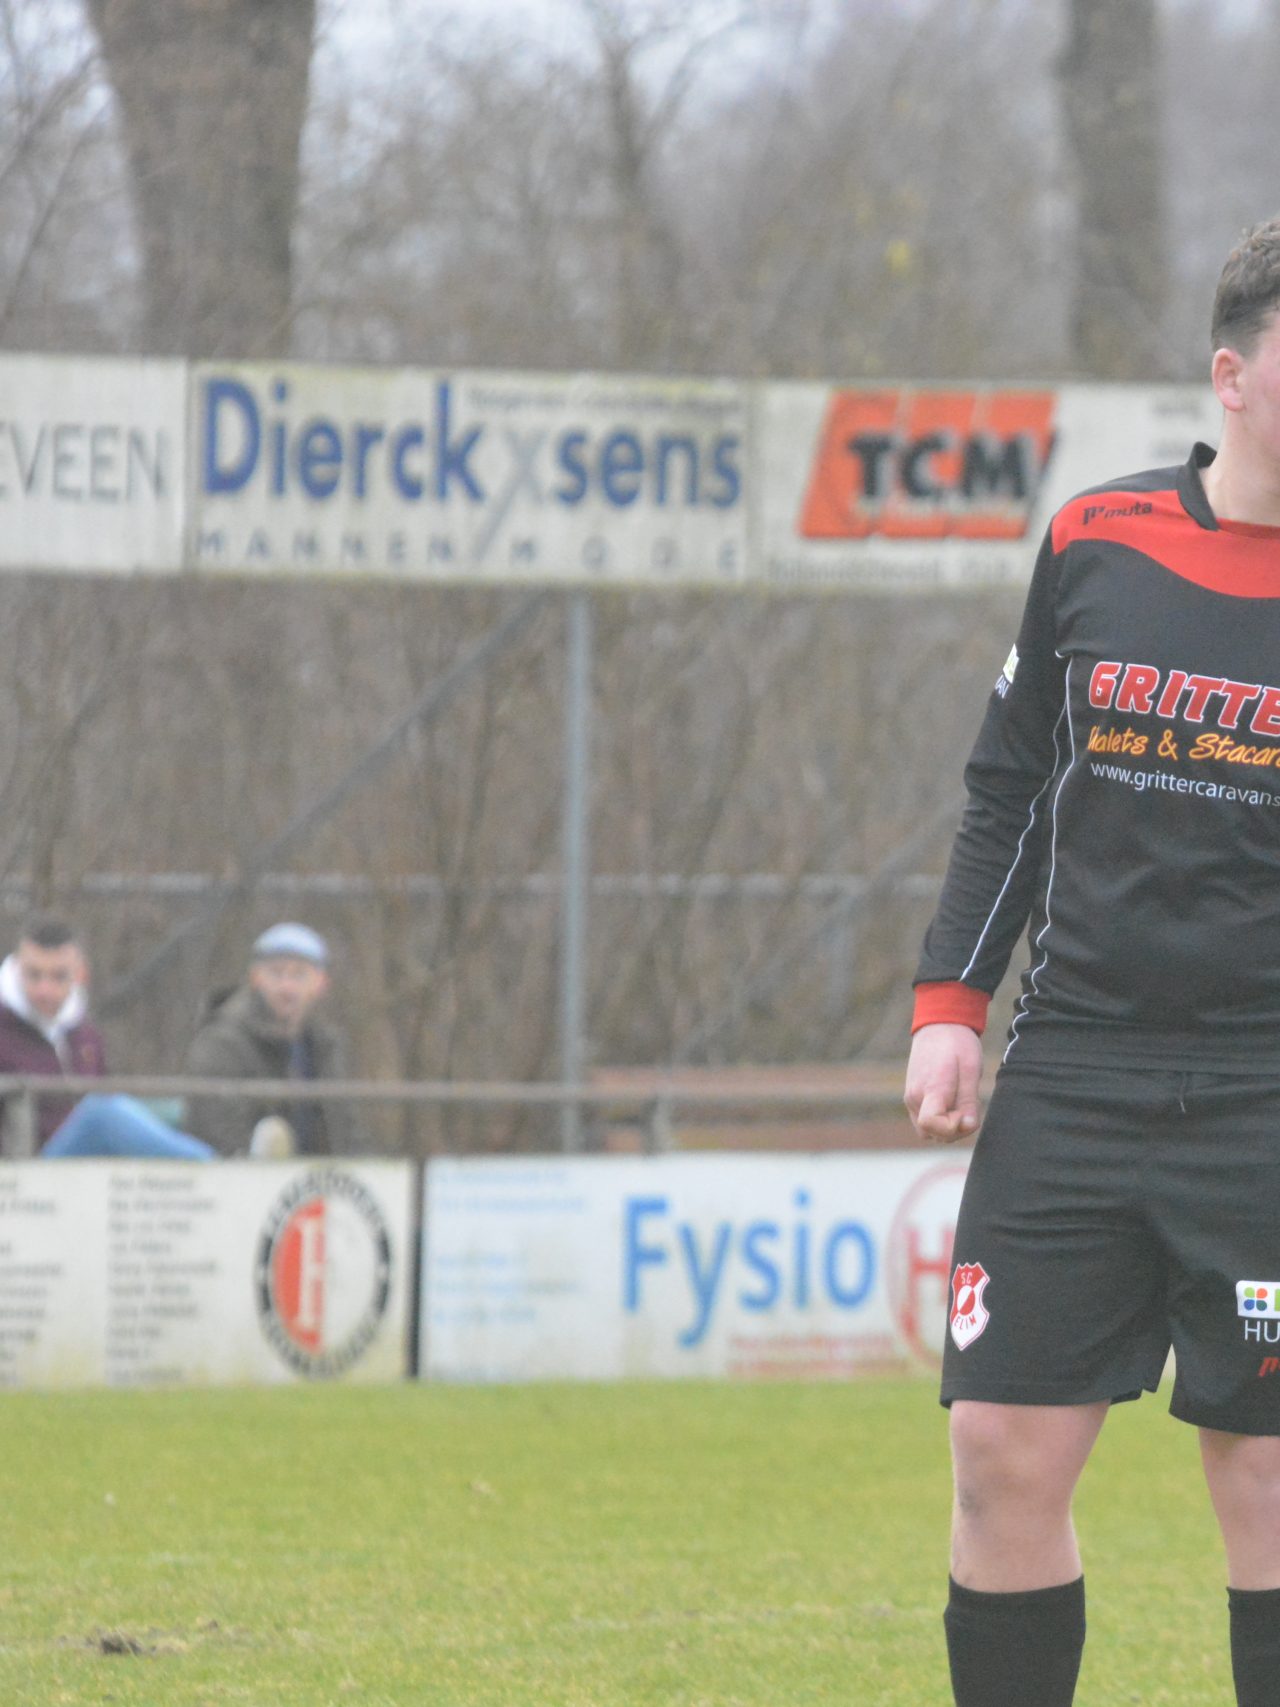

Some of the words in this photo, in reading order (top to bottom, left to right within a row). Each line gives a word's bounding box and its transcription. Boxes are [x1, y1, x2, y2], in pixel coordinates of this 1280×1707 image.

[203, 376, 743, 509] Dierckxsens
[847, 428, 1060, 502] TCM
[200, 527, 454, 563] MANNEN
[1157, 728, 1178, 760] &
[622, 1187, 879, 1350] Fysio
[961, 1272, 973, 1285] SC
